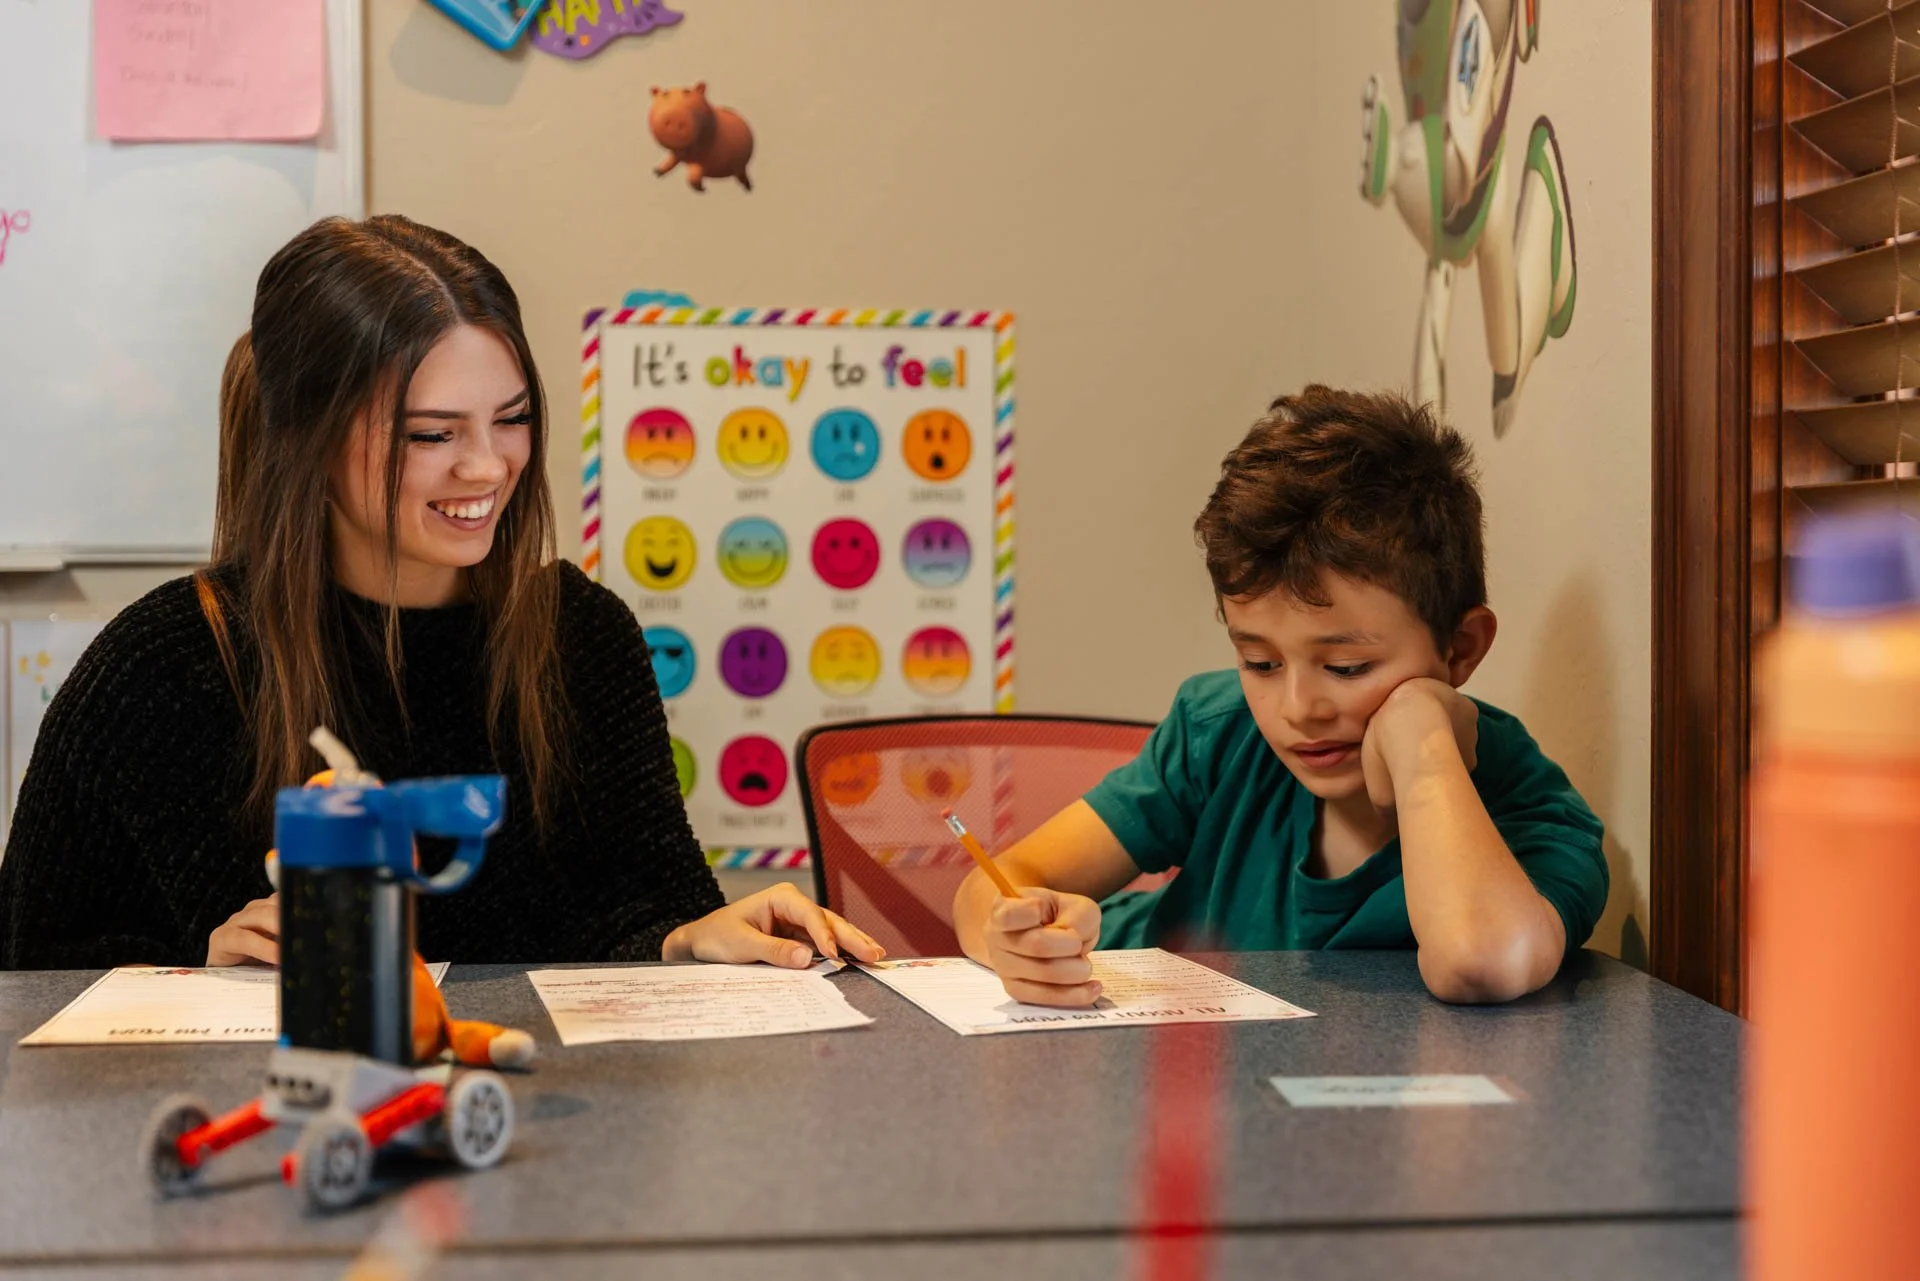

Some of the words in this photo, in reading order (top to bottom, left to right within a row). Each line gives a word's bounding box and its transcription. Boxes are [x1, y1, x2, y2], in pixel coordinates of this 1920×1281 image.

[632, 343, 689, 389] It's
[703, 343, 810, 404] okay
[826, 345, 867, 389] to
[881, 344, 968, 390] feel
